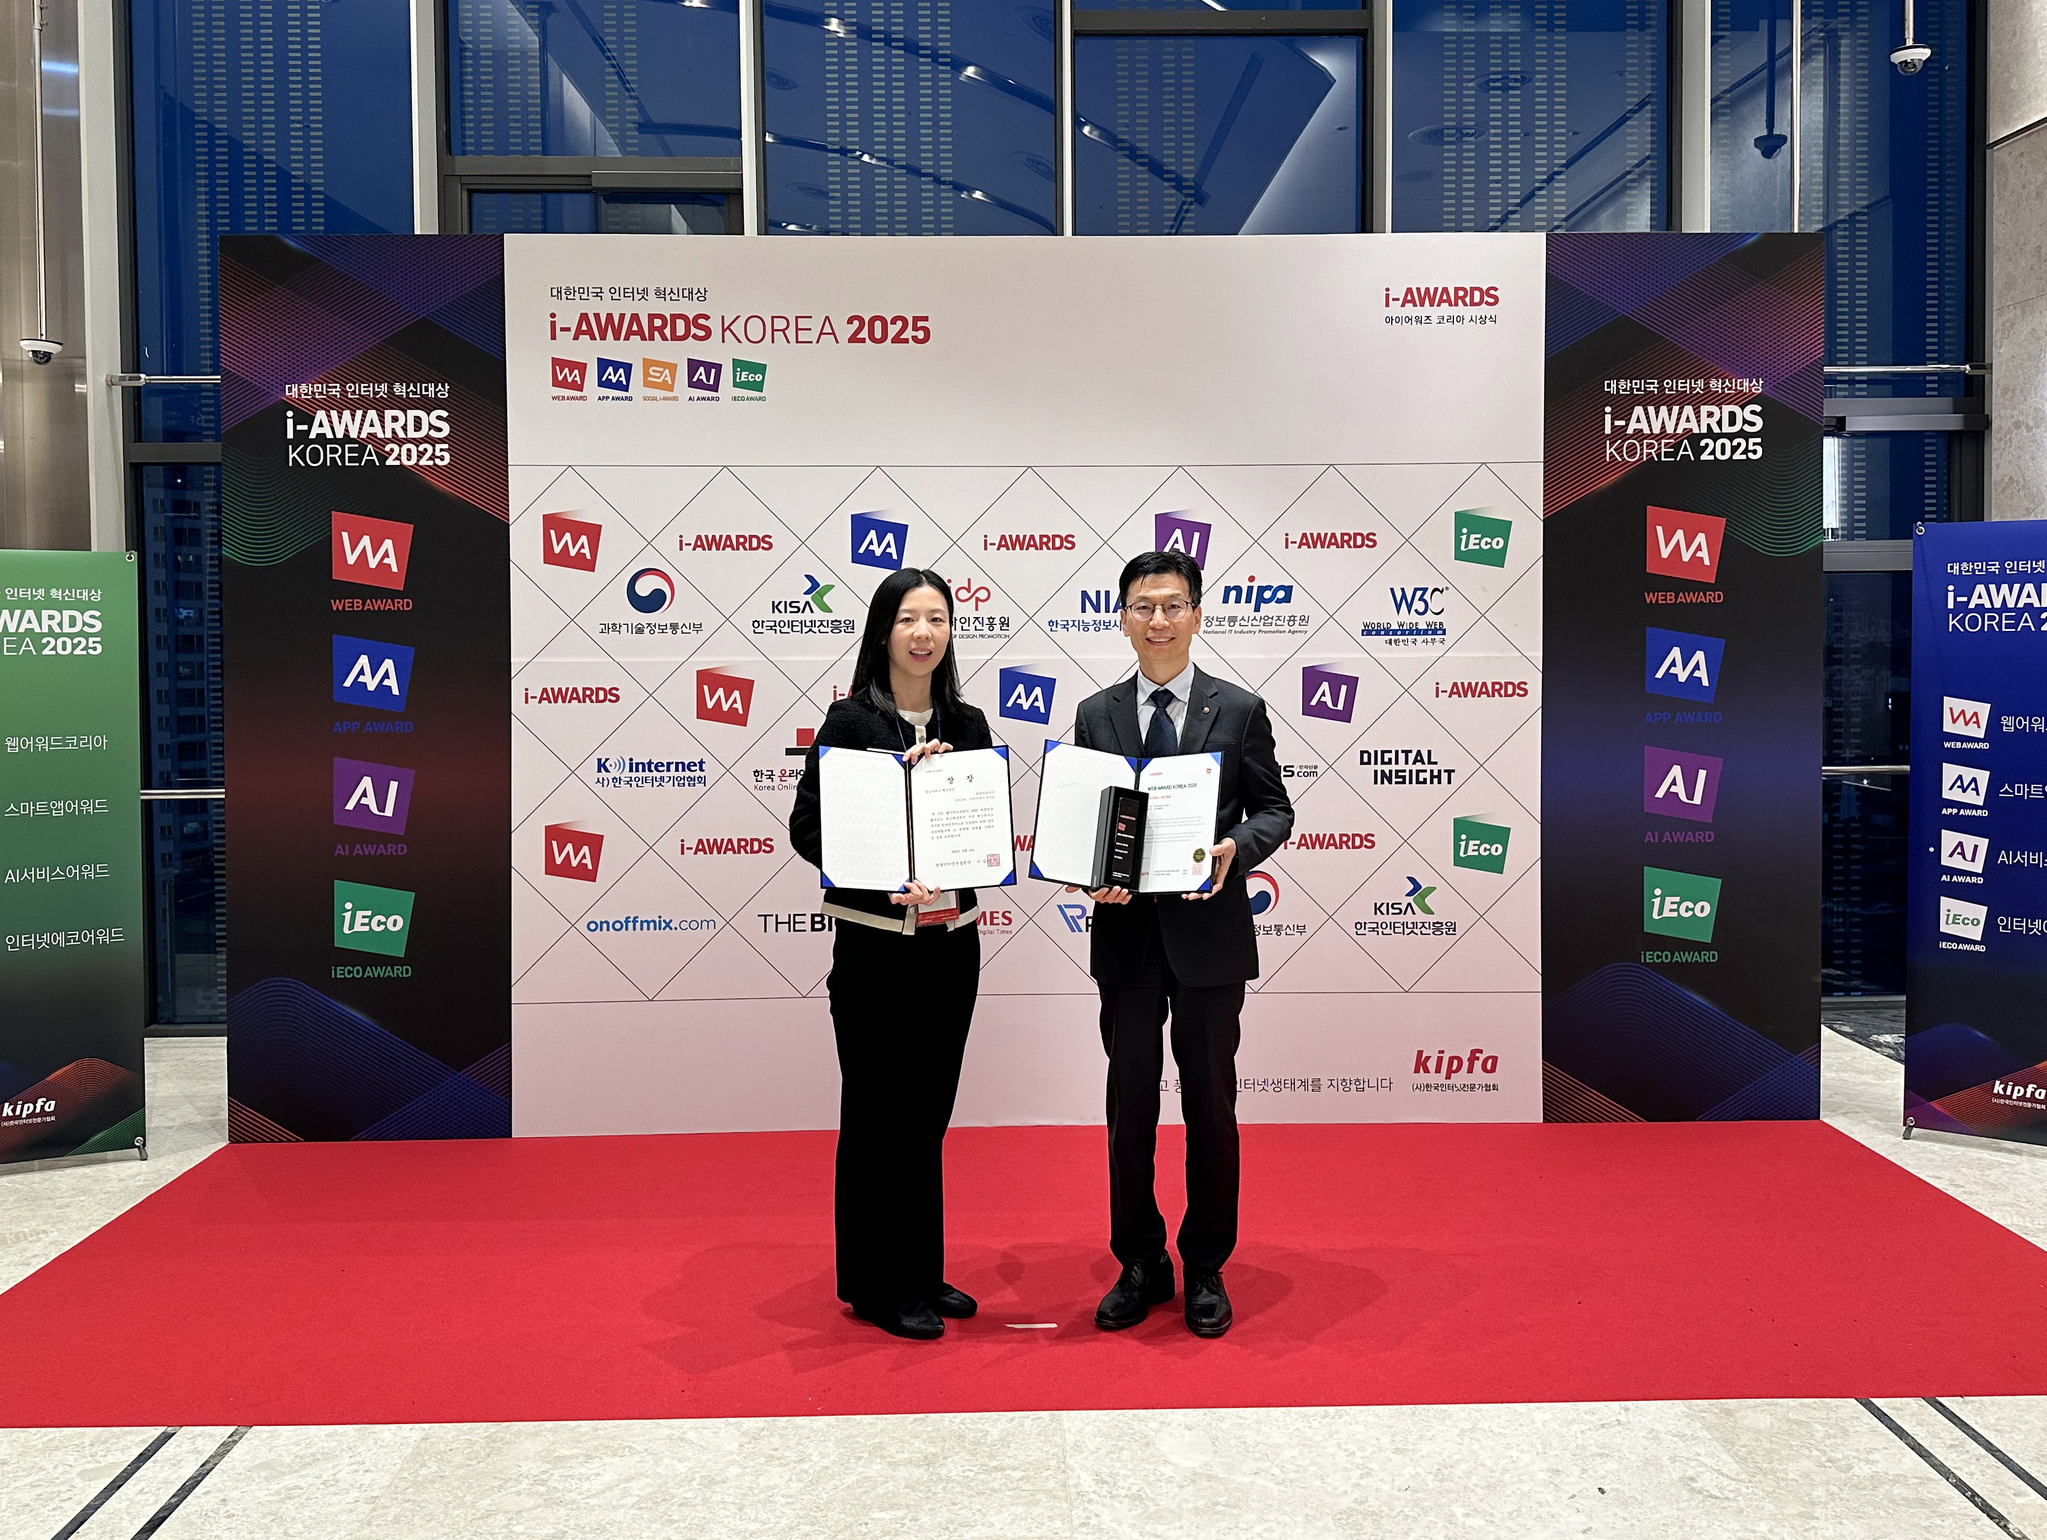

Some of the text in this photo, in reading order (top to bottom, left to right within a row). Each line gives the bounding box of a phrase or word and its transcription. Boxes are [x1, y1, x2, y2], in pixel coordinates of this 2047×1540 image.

[550, 286, 709, 302] 대한민국 인터넷 혁신대상
[1384, 286, 1500, 308] i-AWARDS
[549, 312, 932, 345] i-AWARDS KOREA 2025
[1384, 314, 1498, 325] 아이어워즈 코리아 시상식
[555, 365, 581, 385] WA
[601, 365, 627, 386] AA
[647, 366, 672, 385] SA
[692, 366, 716, 386] AI
[736, 367, 763, 383] iEco
[285, 382, 450, 399] 대한민국 인터넷 혁신대상
[1604, 377, 1764, 395] 대한민국 인터넷 혁신대상
[285, 409, 450, 439] i-AWARDS
[1604, 404, 1764, 434] i-AWARDS
[288, 443, 450, 467] KOREA 2025
[1606, 437, 1763, 462] KOREA 2025
[549, 528, 592, 560] WA
[678, 534, 774, 551] i-AWARDS
[857, 529, 899, 560] AA
[983, 533, 1076, 551] i-AWARDS
[1284, 532, 1378, 549] i-AWARDS
[1459, 527, 1504, 551] iEco
[1655, 525, 1711, 566] WA
[341, 531, 398, 573] WA
[1947, 560, 2046, 575] 대한민국 인터넷
[5, 587, 103, 602] 인터넷 혁신대상
[1222, 575, 1294, 613] nipa
[1390, 587, 1445, 616] W3C
[1644, 591, 1724, 604] WEB AWARD
[331, 599, 413, 611] WEB AWARD
[771, 600, 815, 614] KISA
[599, 622, 704, 635] 과학기술정보통신부
[752, 618, 856, 635] 한국인터넷진흥원
[1203, 614, 1310, 628] 정보통신산업진흥원
[1362, 621, 1444, 629] WORLD WIDE WEB
[1948, 612, 2036, 632] KOREA
[41, 637, 103, 656] 2025
[1385, 638, 1446, 646] 대한민국 사무국
[342, 654, 400, 696] AA
[1654, 646, 1710, 687] AA
[524, 686, 621, 704] i-AWARDS
[1006, 683, 1046, 713] AA
[1309, 681, 1348, 711] AI
[1435, 681, 1529, 698] i-AWARDS
[702, 684, 744, 715] WA
[333, 721, 414, 734] APP AWARD
[1644, 712, 1723, 724] APP AWARD
[1949, 707, 1981, 729] WA
[5, 734, 108, 753] 웹어워드코리아
[1943, 741, 1990, 750] WEB AWARD
[628, 757, 706, 773] internet
[1359, 750, 1438, 765] DIGITAL
[753, 769, 775, 782] 한국
[1373, 769, 1456, 785] INSIGHT
[1654, 764, 1708, 805] AI
[1948, 774, 1980, 797] AA
[344, 775, 399, 818] AI
[4, 799, 109, 818] 스마트앱어워드
[1941, 808, 1988, 817] APP AWARD
[680, 837, 775, 855] i-AWARDS
[1458, 834, 1503, 857] iEco
[1644, 830, 1715, 843] AI AWARD
[334, 844, 408, 856] AI AWARD
[551, 840, 593, 870] WA
[1947, 841, 1979, 863] AI
[4, 863, 110, 884] AI서비스어워드
[1951, 875, 1984, 884] AWARD
[1374, 902, 1417, 916] KISA
[1651, 888, 1711, 920] iEco
[341, 901, 404, 934] iEco
[586, 915, 717, 932] onoffmix.com
[1945, 908, 1981, 927] iEco
[1354, 921, 1457, 937] 한국인터넷진흥원
[5, 927, 126, 952] 인터넷에코어워드
[1939, 941, 1986, 952] iECO AWARD
[1641, 951, 1719, 964] iECO AWARD
[331, 965, 412, 979] iECO AWARD
[1413, 1048, 1499, 1080] kipfa
[1327, 1077, 1394, 1093] 지향합니다
[1993, 1080, 2046, 1099] kipfa
[2, 1098, 56, 1118] kipfa
